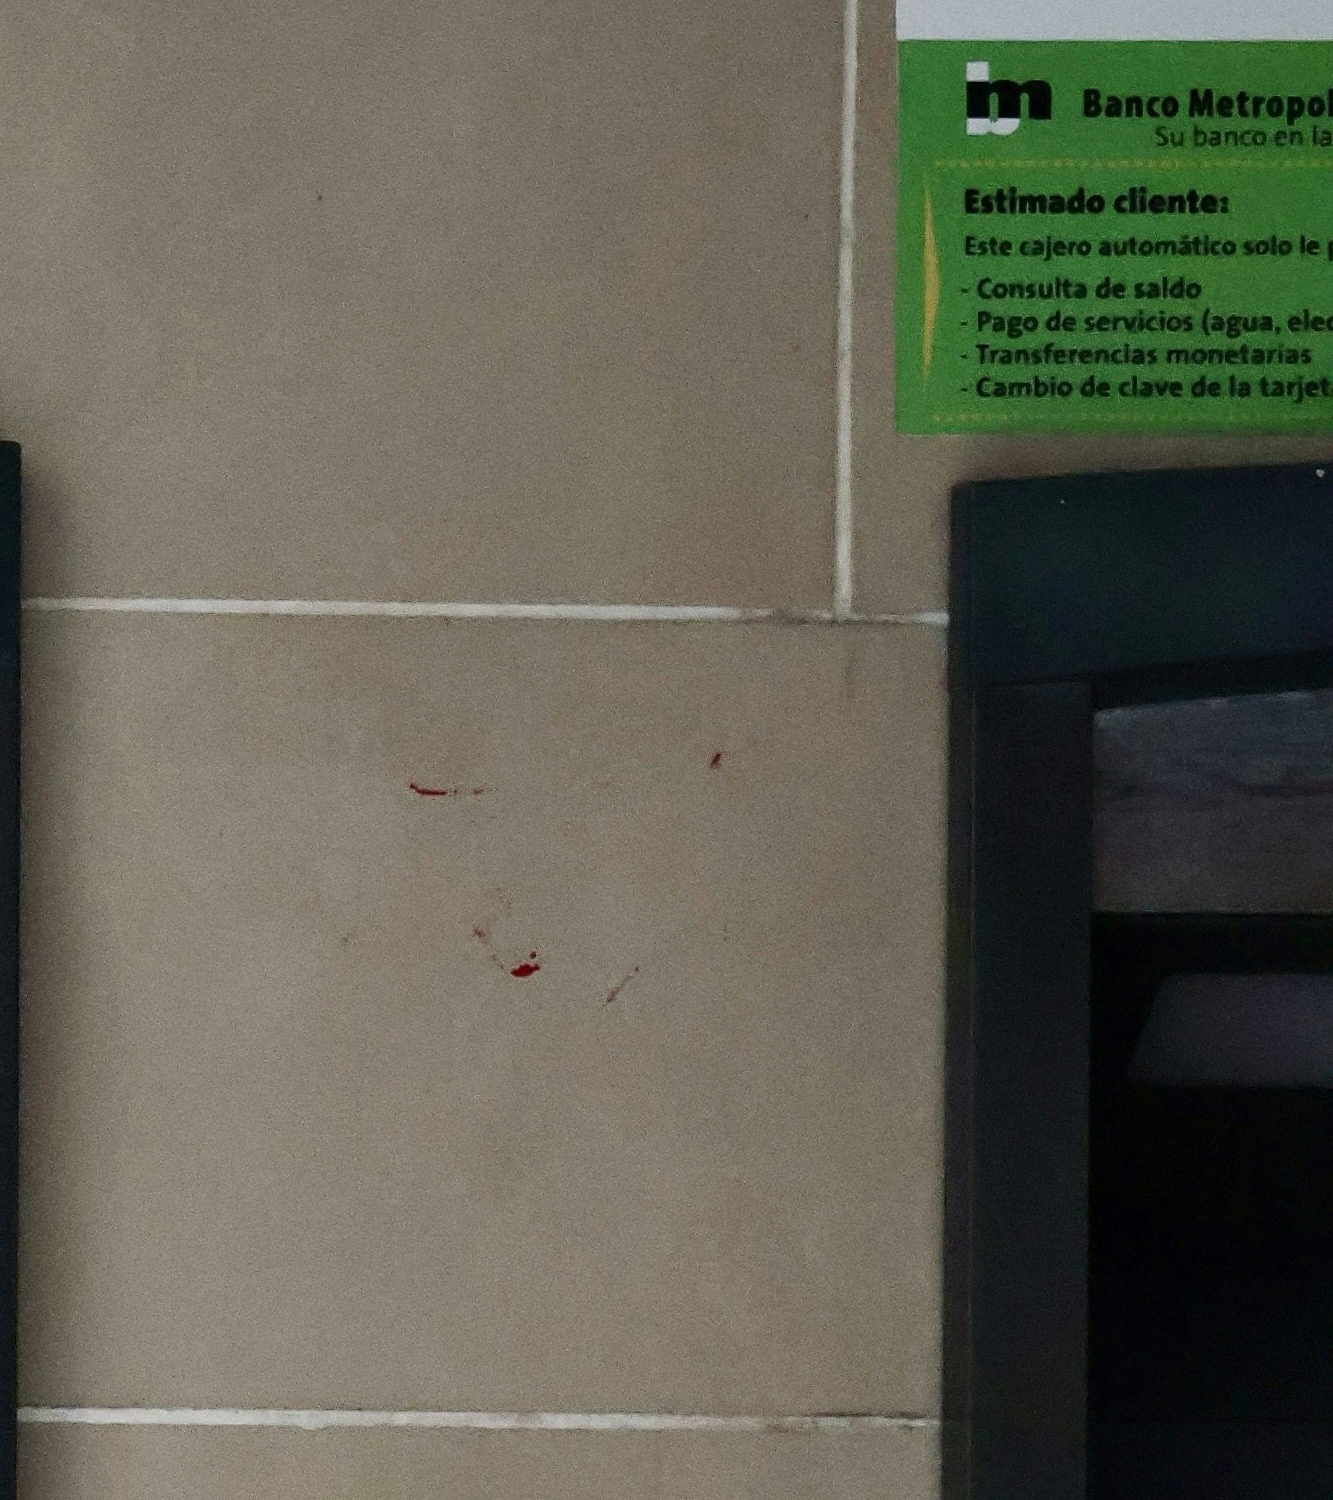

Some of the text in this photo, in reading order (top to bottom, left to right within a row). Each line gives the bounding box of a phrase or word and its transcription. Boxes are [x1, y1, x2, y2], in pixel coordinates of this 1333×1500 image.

[1083, 88, 1333, 126] Banco Metropol
[1155, 125, 1185, 148] Su
[1192, 124, 1268, 147] banco
[1273, 129, 1304, 147] en
[964, 186, 1229, 215] Estimado cliente:
[964, 235, 1013, 257] Este
[1019, 235, 1093, 262] cajero
[1098, 234, 1237, 257] automático
[1243, 234, 1293, 256] solo
[1299, 234, 1320, 256] le
[977, 276, 1202, 300] Consulta de saldo
[977, 310, 1039, 340] Pago
[1045, 309, 1077, 333] de
[1084, 309, 1194, 333] servicios
[1201, 307, 1282, 339] (agua,
[975, 342, 1312, 366] Transferencias monetarias
[975, 374, 1333, 404] Cambio de clave de la tarjet
